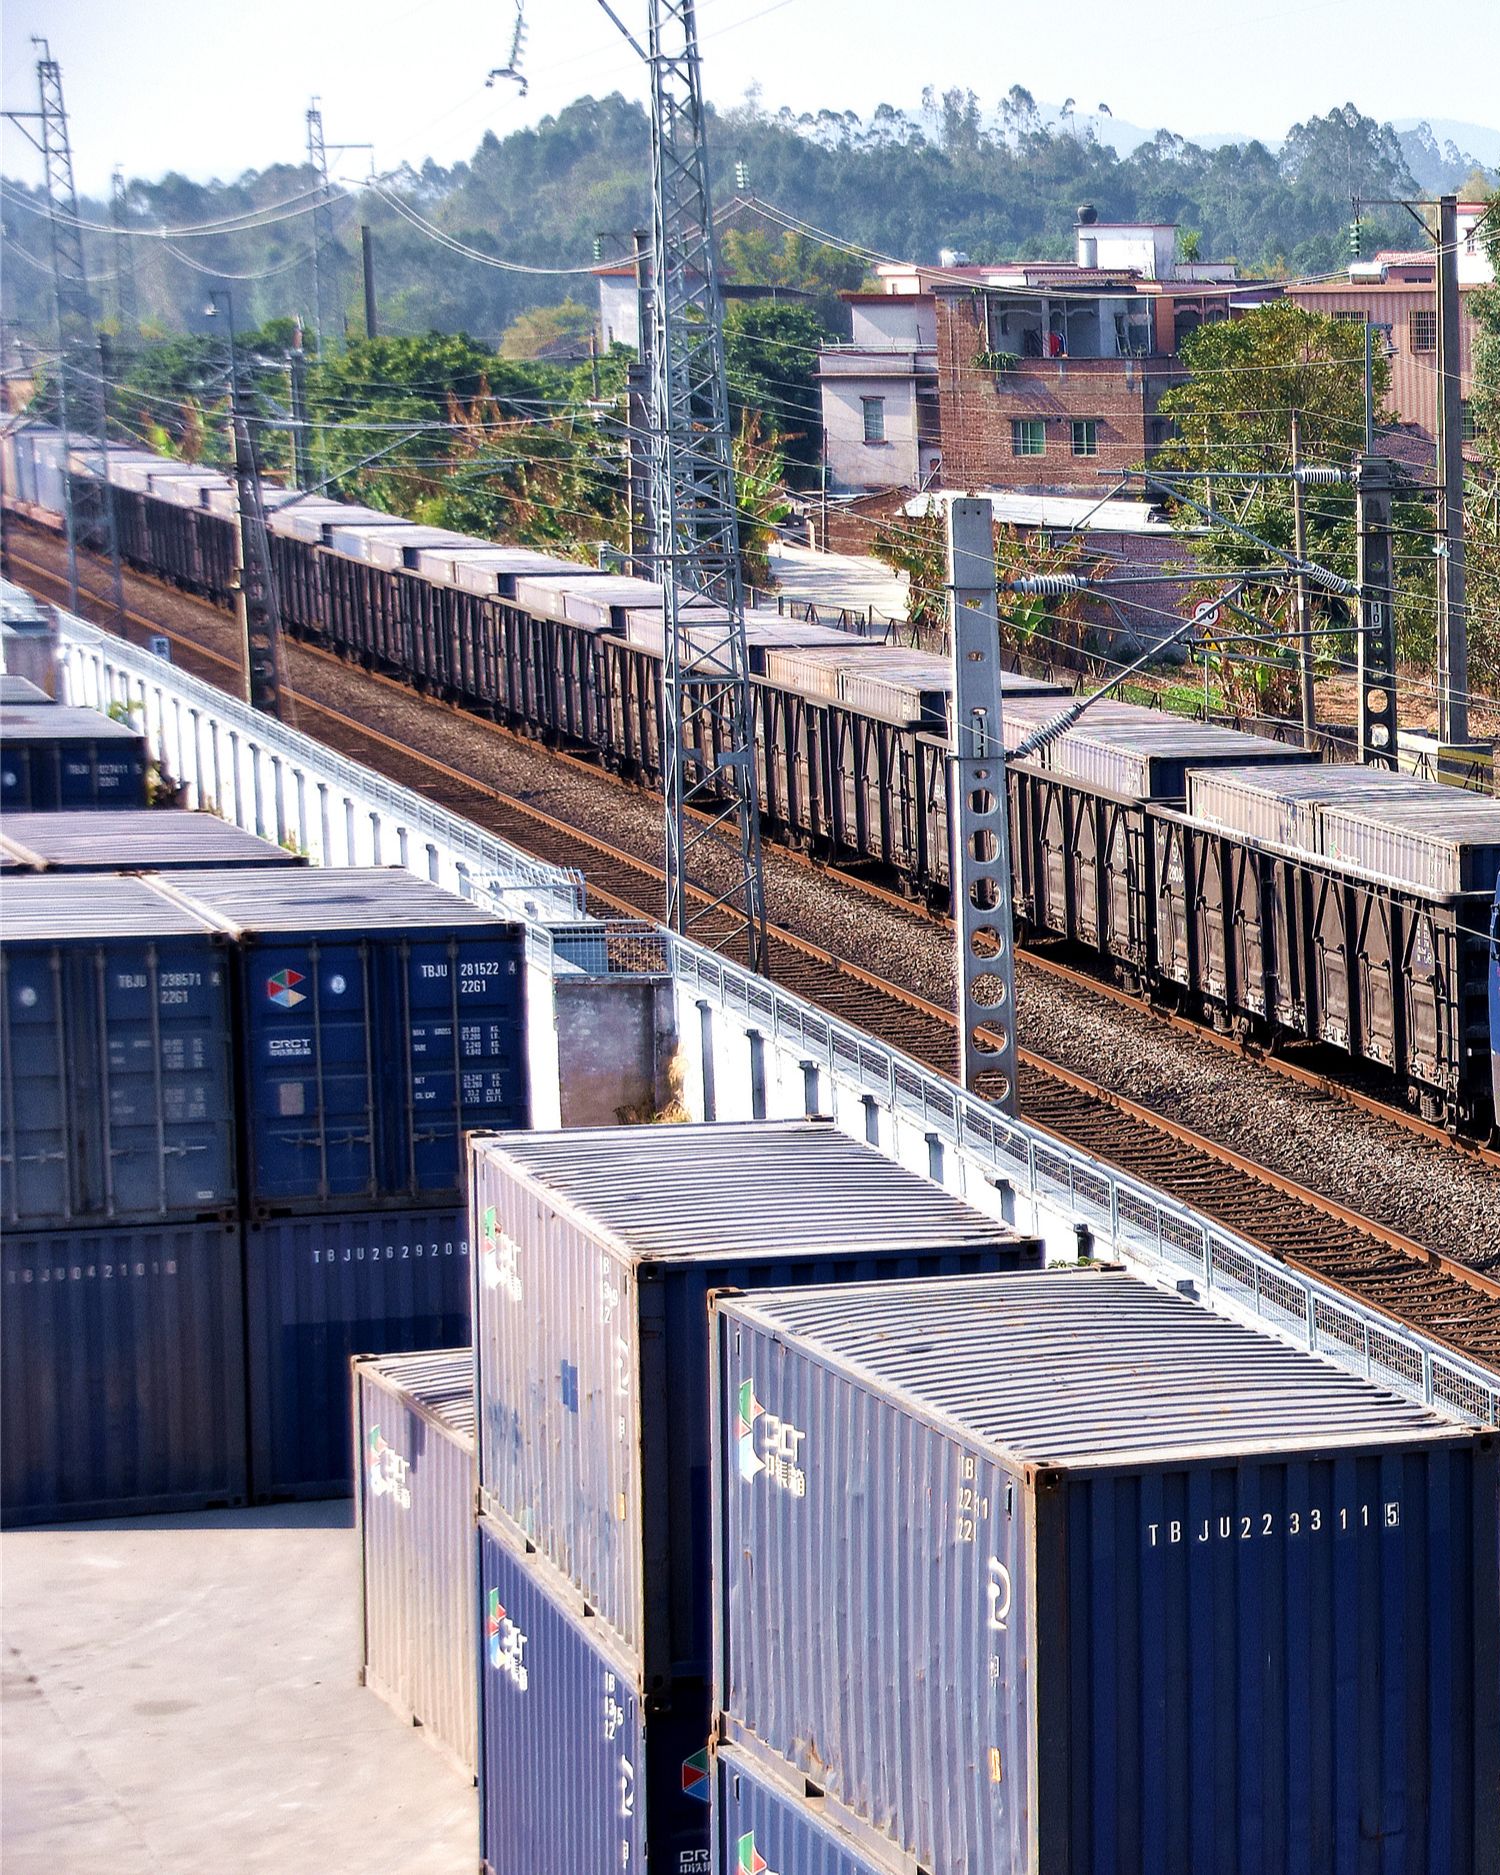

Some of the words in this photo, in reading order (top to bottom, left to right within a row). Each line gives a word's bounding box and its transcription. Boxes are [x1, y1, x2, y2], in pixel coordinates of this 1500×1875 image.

[421, 964, 448, 978] TBJU
[461, 962, 499, 977] 281522
[508, 960, 517, 975] 4
[119, 974, 147, 988] TBJU
[161, 972, 201, 987] 238571
[461, 980, 487, 993] 22G1
[161, 990, 188, 1004] 22G1
[269, 1039, 311, 1049] CRCT
[313, 1242, 468, 1263] TBJU2629209
[1149, 1502, 1400, 1546] TBJU2233115
